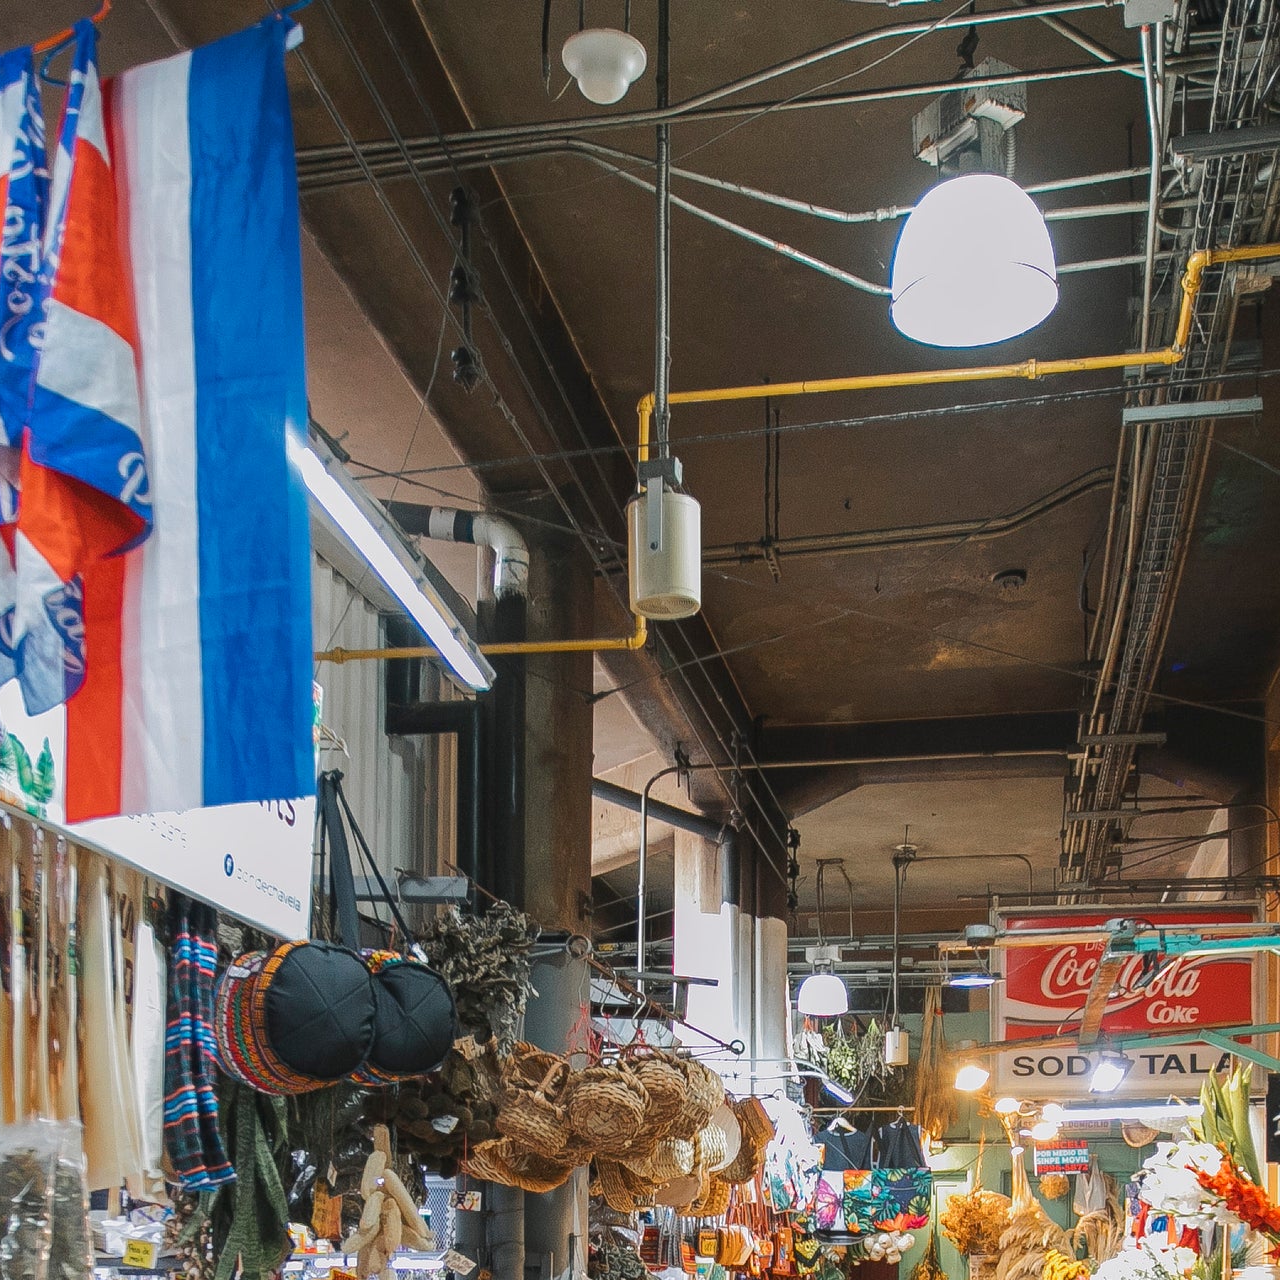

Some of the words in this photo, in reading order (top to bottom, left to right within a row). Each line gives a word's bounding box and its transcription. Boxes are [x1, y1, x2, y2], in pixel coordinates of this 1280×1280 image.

[1147, 1000, 1200, 1024] Coke
[1012, 1055, 1092, 1077] SOD
[1036, 1139, 1088, 1150] CANCELE
[1036, 1150, 1052, 1158] POR
[1053, 1149, 1076, 1157] MEDIO
[1077, 1148, 1088, 1156] DE
